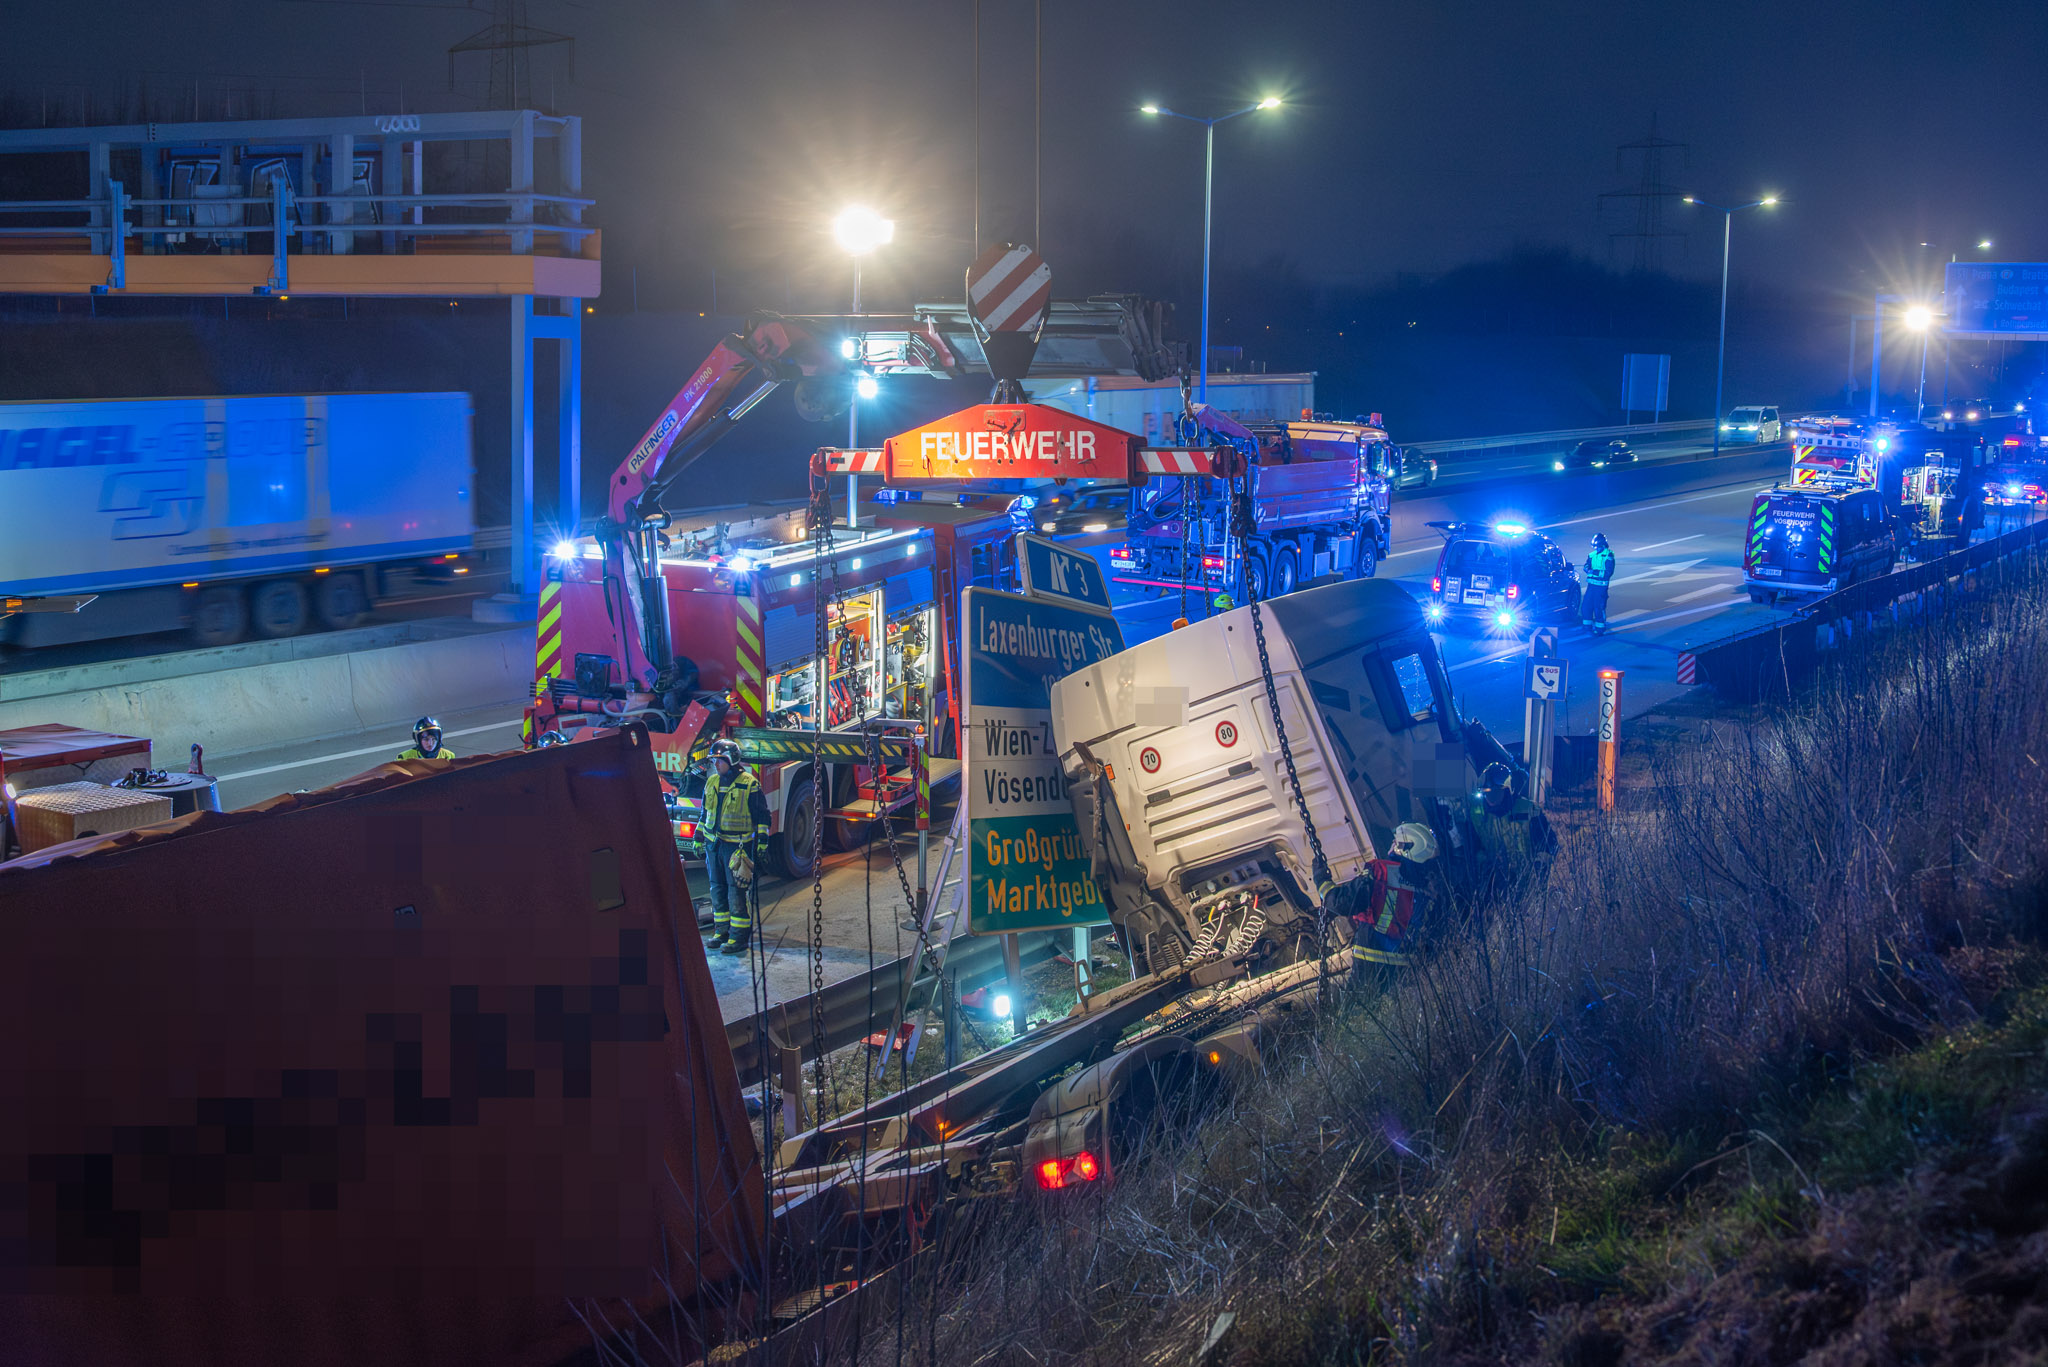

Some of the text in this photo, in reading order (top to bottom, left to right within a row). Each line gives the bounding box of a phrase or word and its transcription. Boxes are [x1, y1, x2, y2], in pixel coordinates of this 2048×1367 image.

[630, 413, 677, 471] PALFINGER
[921, 430, 1097, 461] FEUERWEHR
[1772, 510, 1815, 519] FEUERWEHR
[1075, 562, 1089, 596] 3
[980, 606, 1087, 671] Laxenburger
[1602, 680, 1613, 740] SOS
[984, 719, 1055, 756] Wien-Z
[1220, 727, 1233, 740] 80
[1145, 753, 1156, 766] 70
